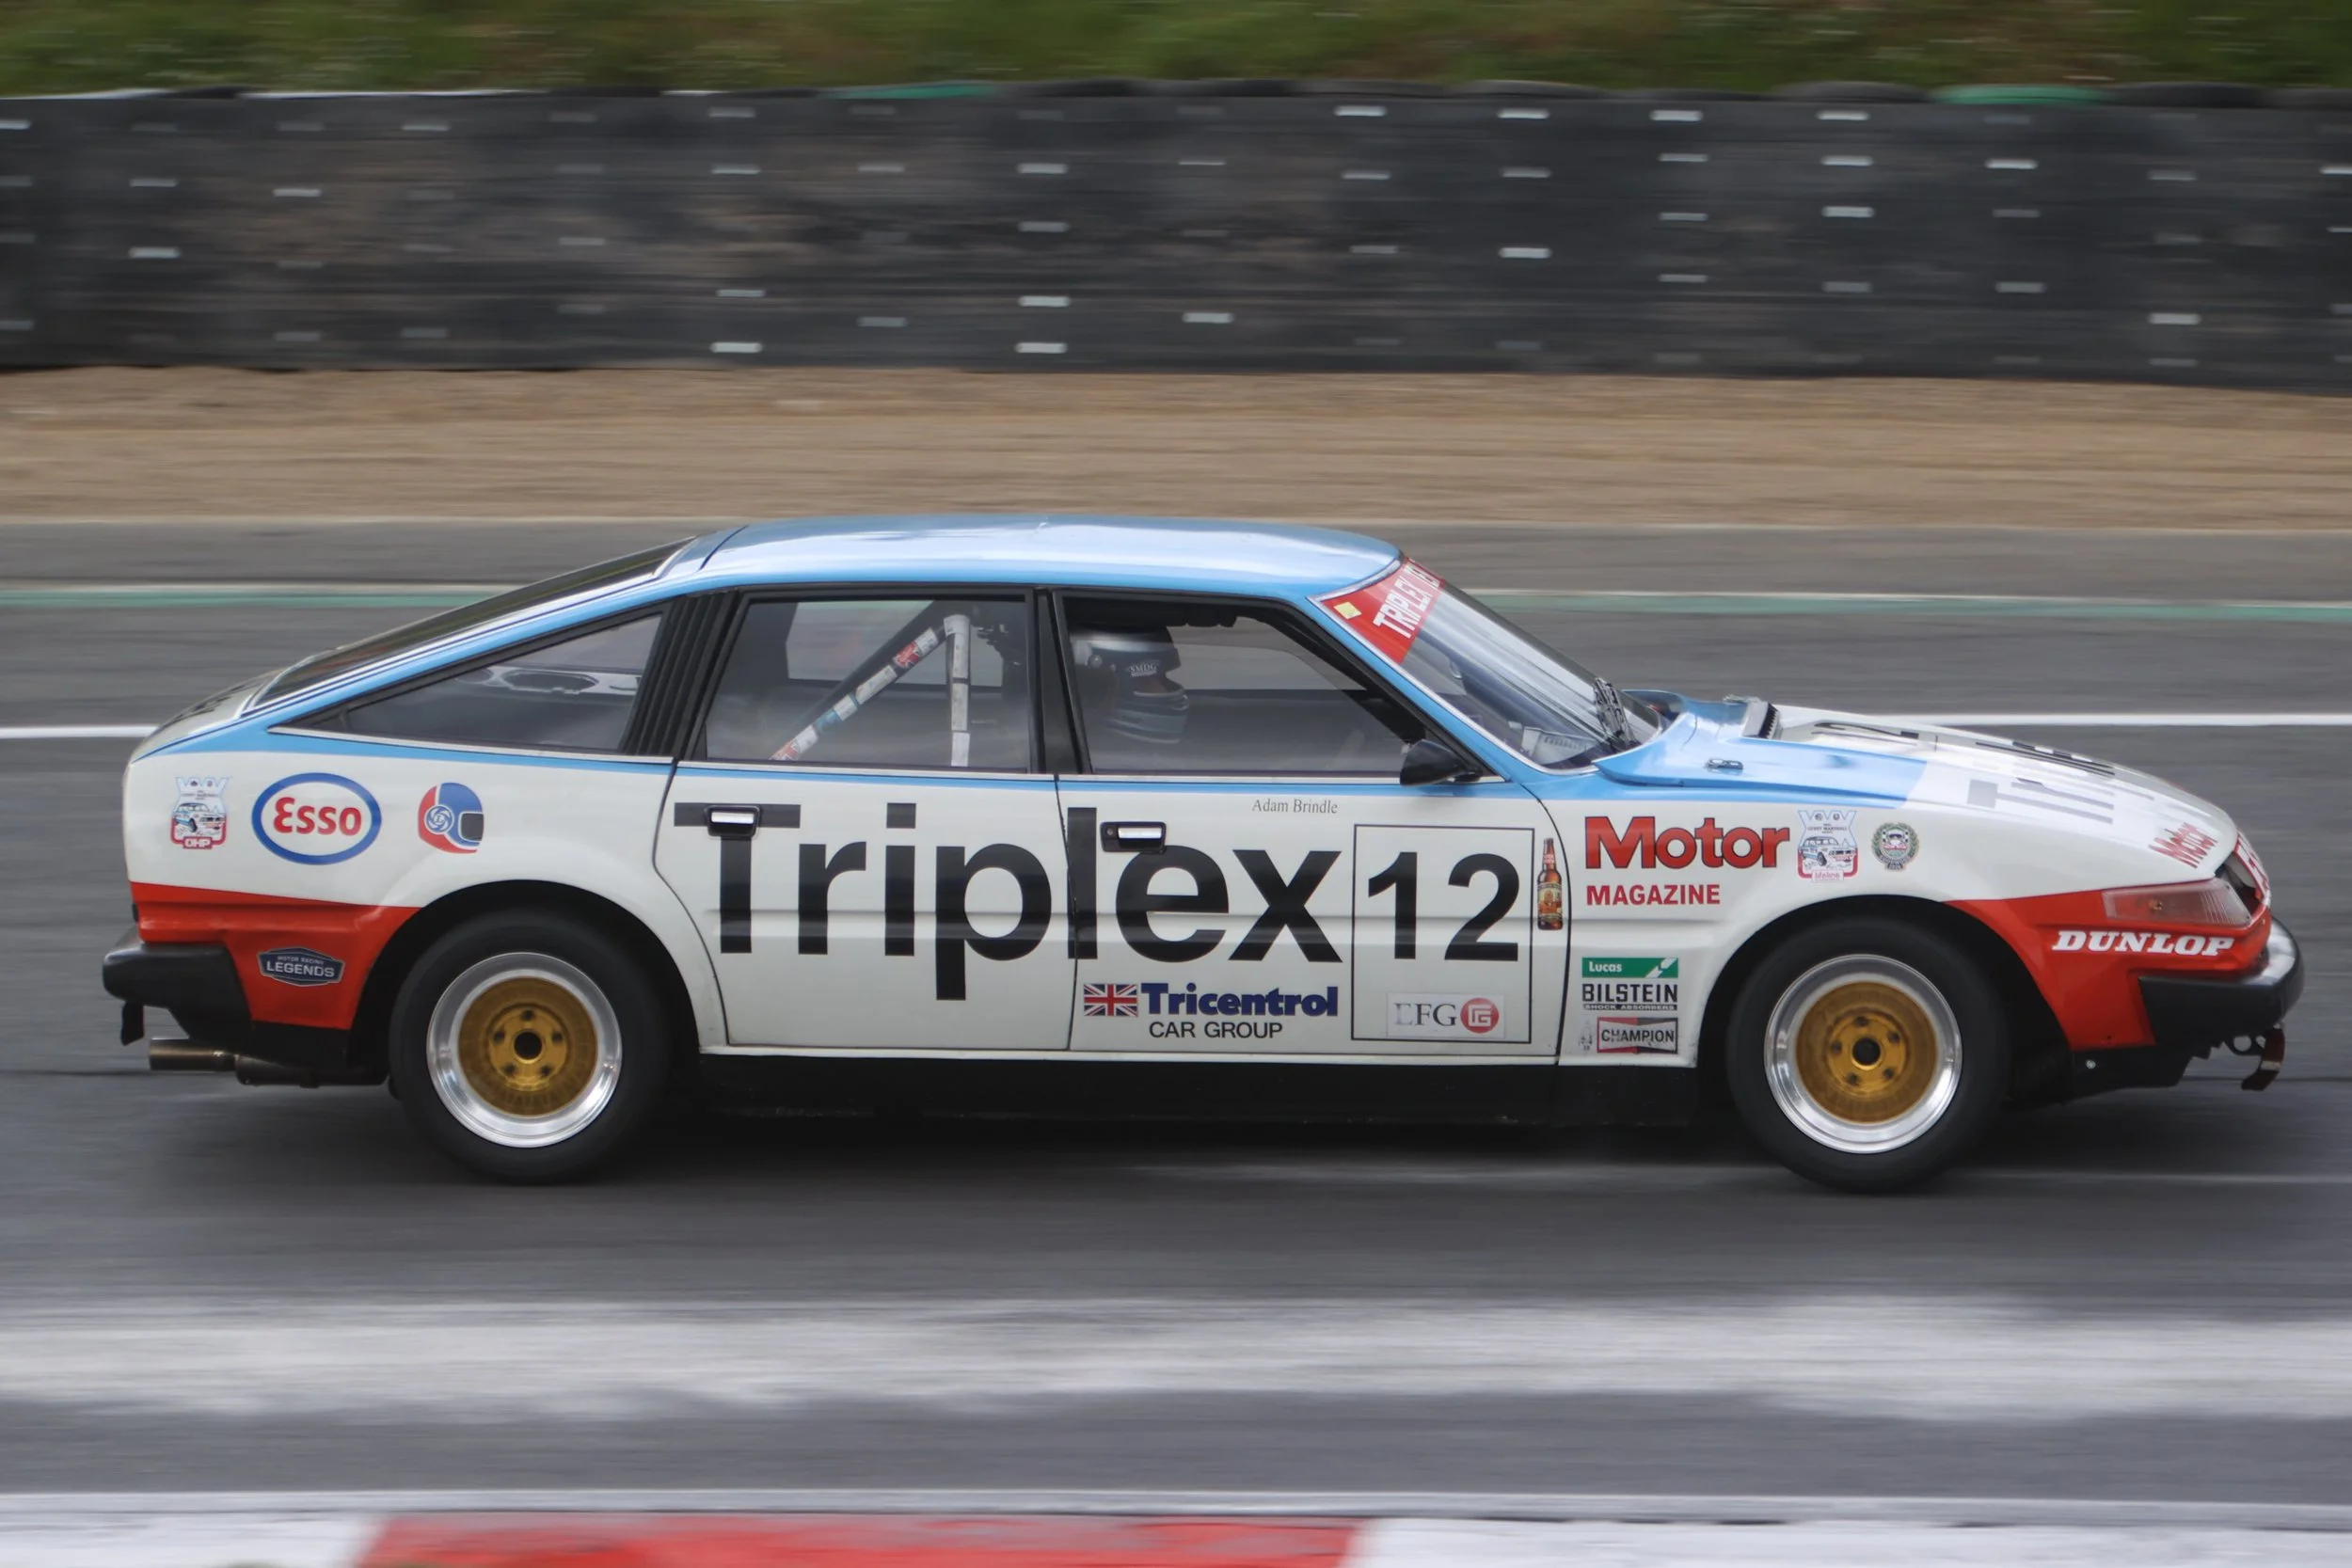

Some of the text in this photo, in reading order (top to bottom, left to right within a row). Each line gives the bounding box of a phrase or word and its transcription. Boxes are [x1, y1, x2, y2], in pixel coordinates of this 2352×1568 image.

[1373, 575, 1433, 639] TRIPLEX
[273, 797, 362, 836] Esso
[1252, 798, 1339, 815] Adam Brindle
[1584, 816, 1791, 869] Motor
[674, 802, 1343, 1001] Triplex
[1368, 851, 1520, 962] 12
[1586, 883, 1721, 906] MAGAZINE
[2051, 929, 2235, 957] DUNLOP
[266, 960, 335, 977] LEGENDS
[1589, 961, 1622, 973] Lucas
[1140, 982, 1339, 1018] Tricentrol
[1582, 983, 1678, 1003] BILSTEIN
[1149, 1022, 1283, 1039] CAR GROUP
[1600, 1029, 1675, 1043] CHAMPION
